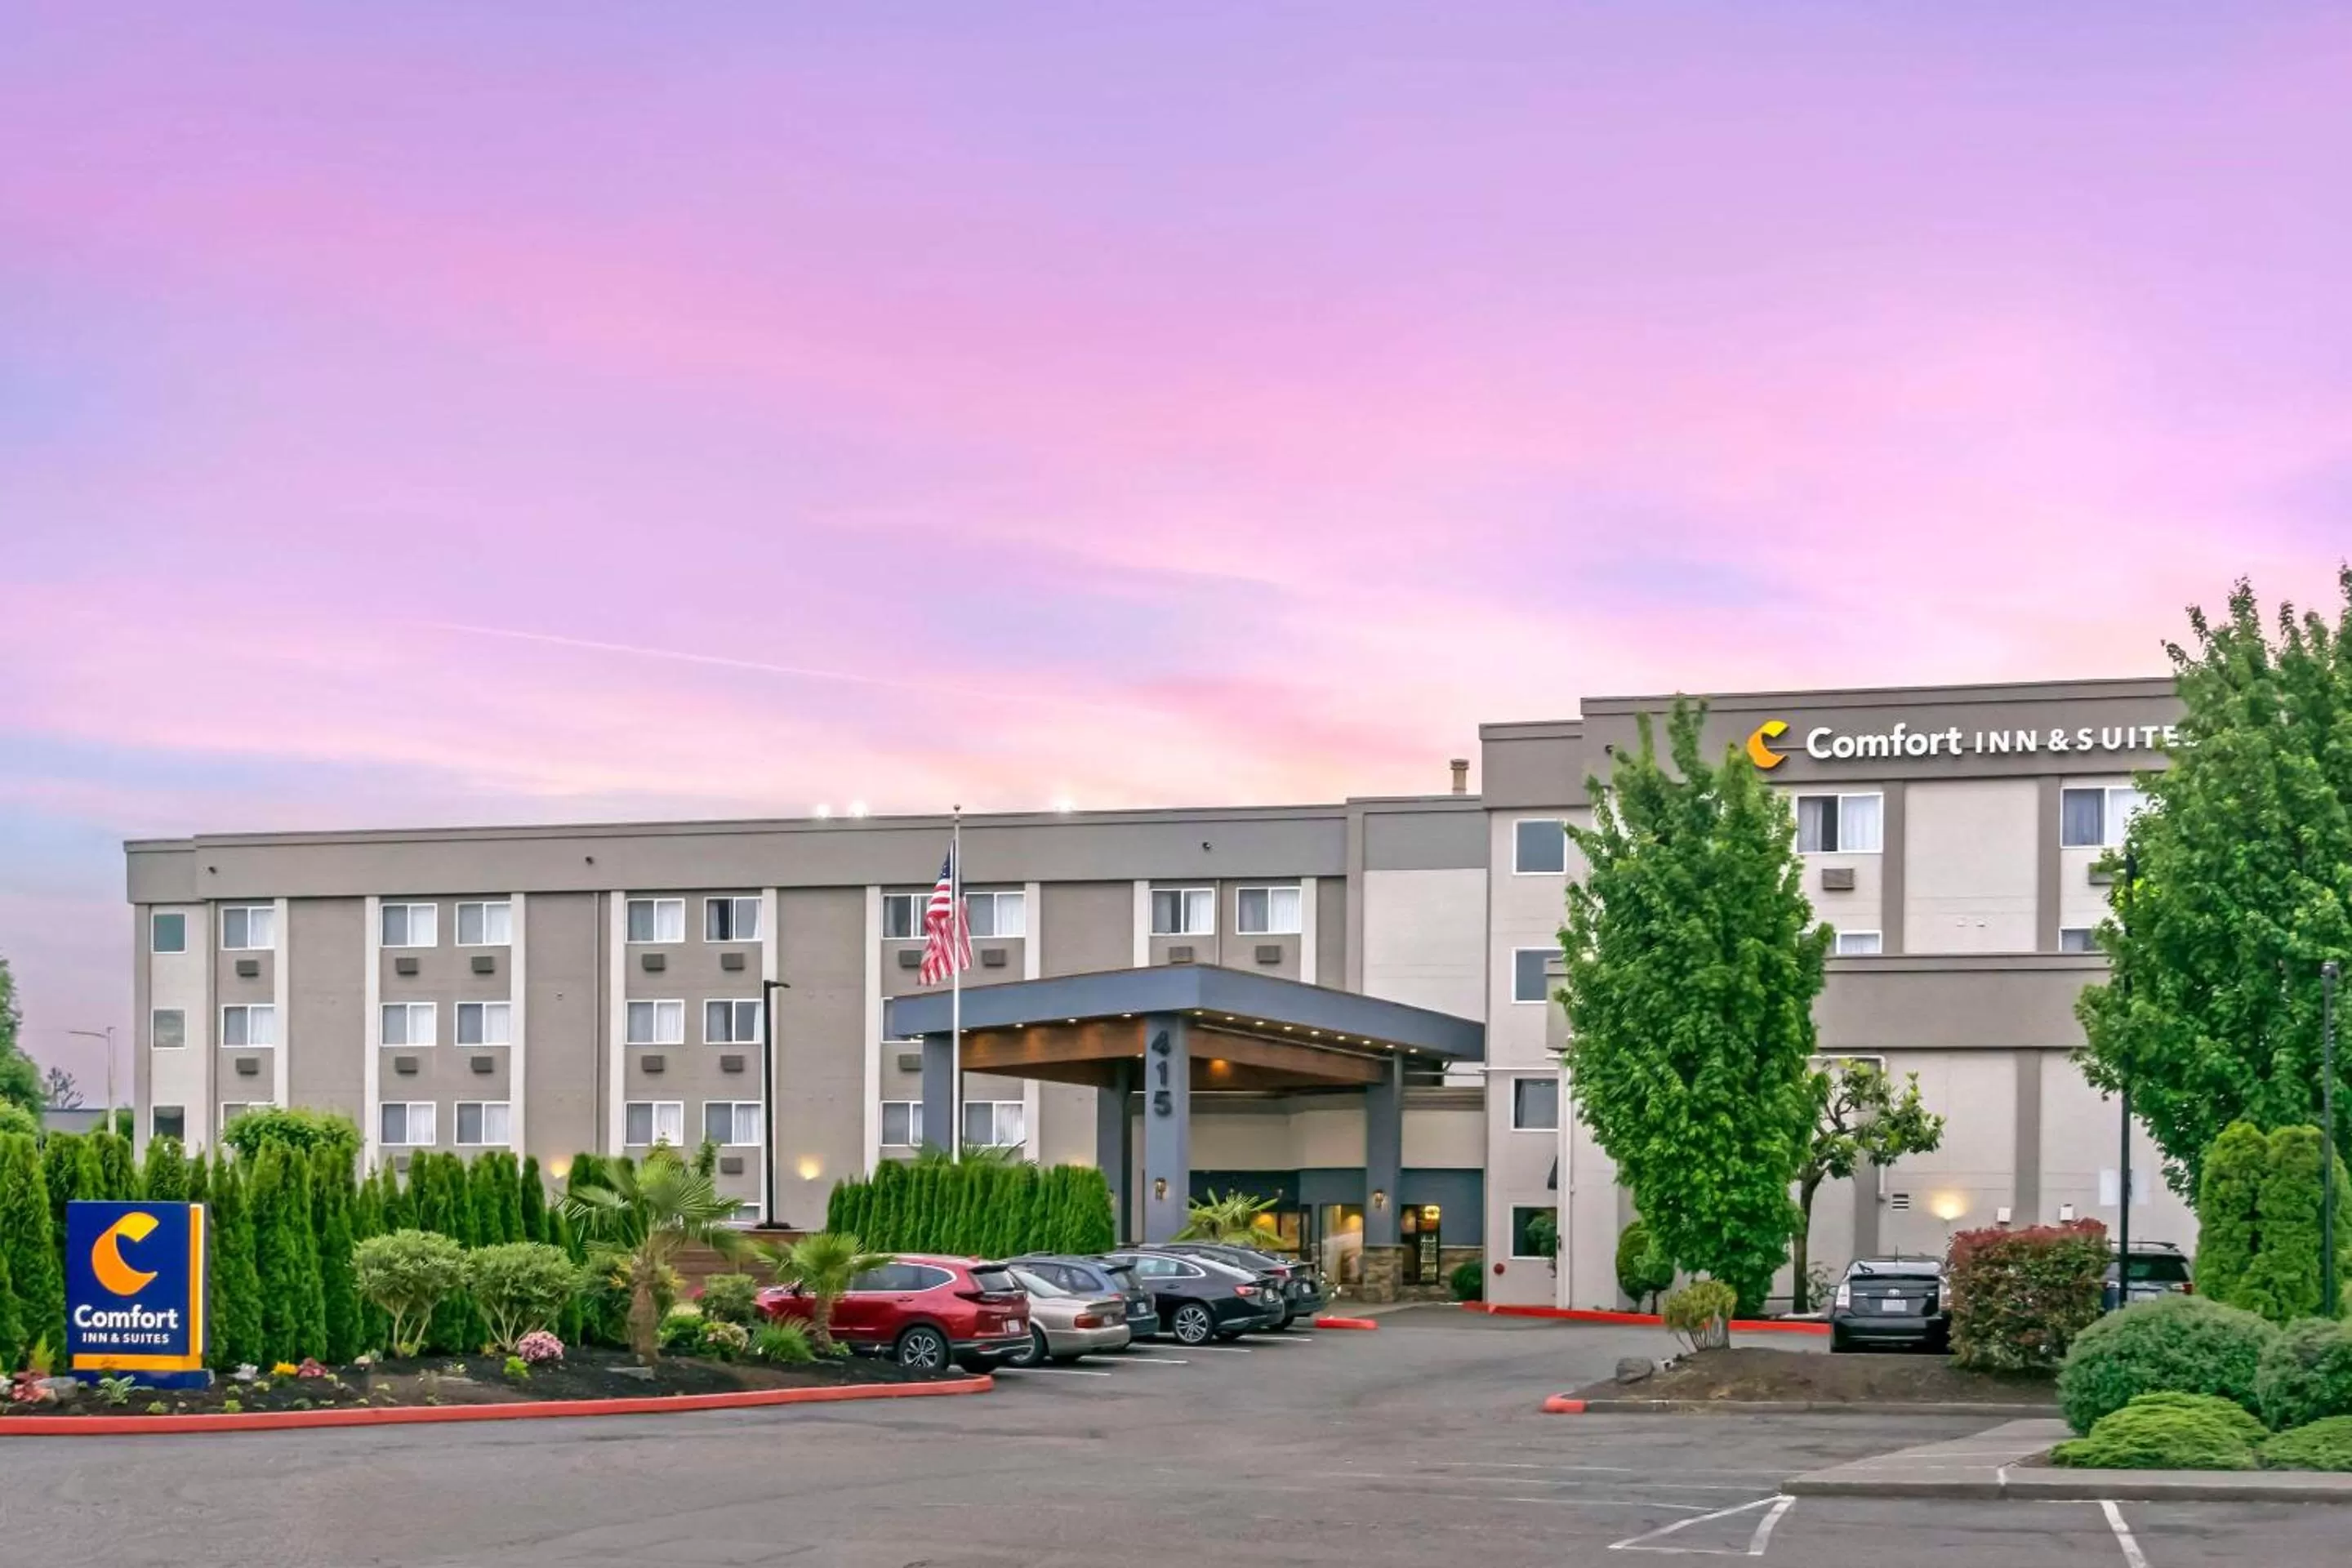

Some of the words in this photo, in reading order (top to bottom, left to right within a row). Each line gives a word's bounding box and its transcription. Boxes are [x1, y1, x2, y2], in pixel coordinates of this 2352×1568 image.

[1806, 723, 1962, 759] Comfort
[1976, 729, 2037, 753] INN
[2047, 728, 2069, 751] &
[1151, 1030, 1173, 1118] 415
[74, 1304, 178, 1329] Comfort
[82, 1333, 108, 1343] INN
[110, 1333, 119, 1343] &
[122, 1333, 170, 1343] SUITES
